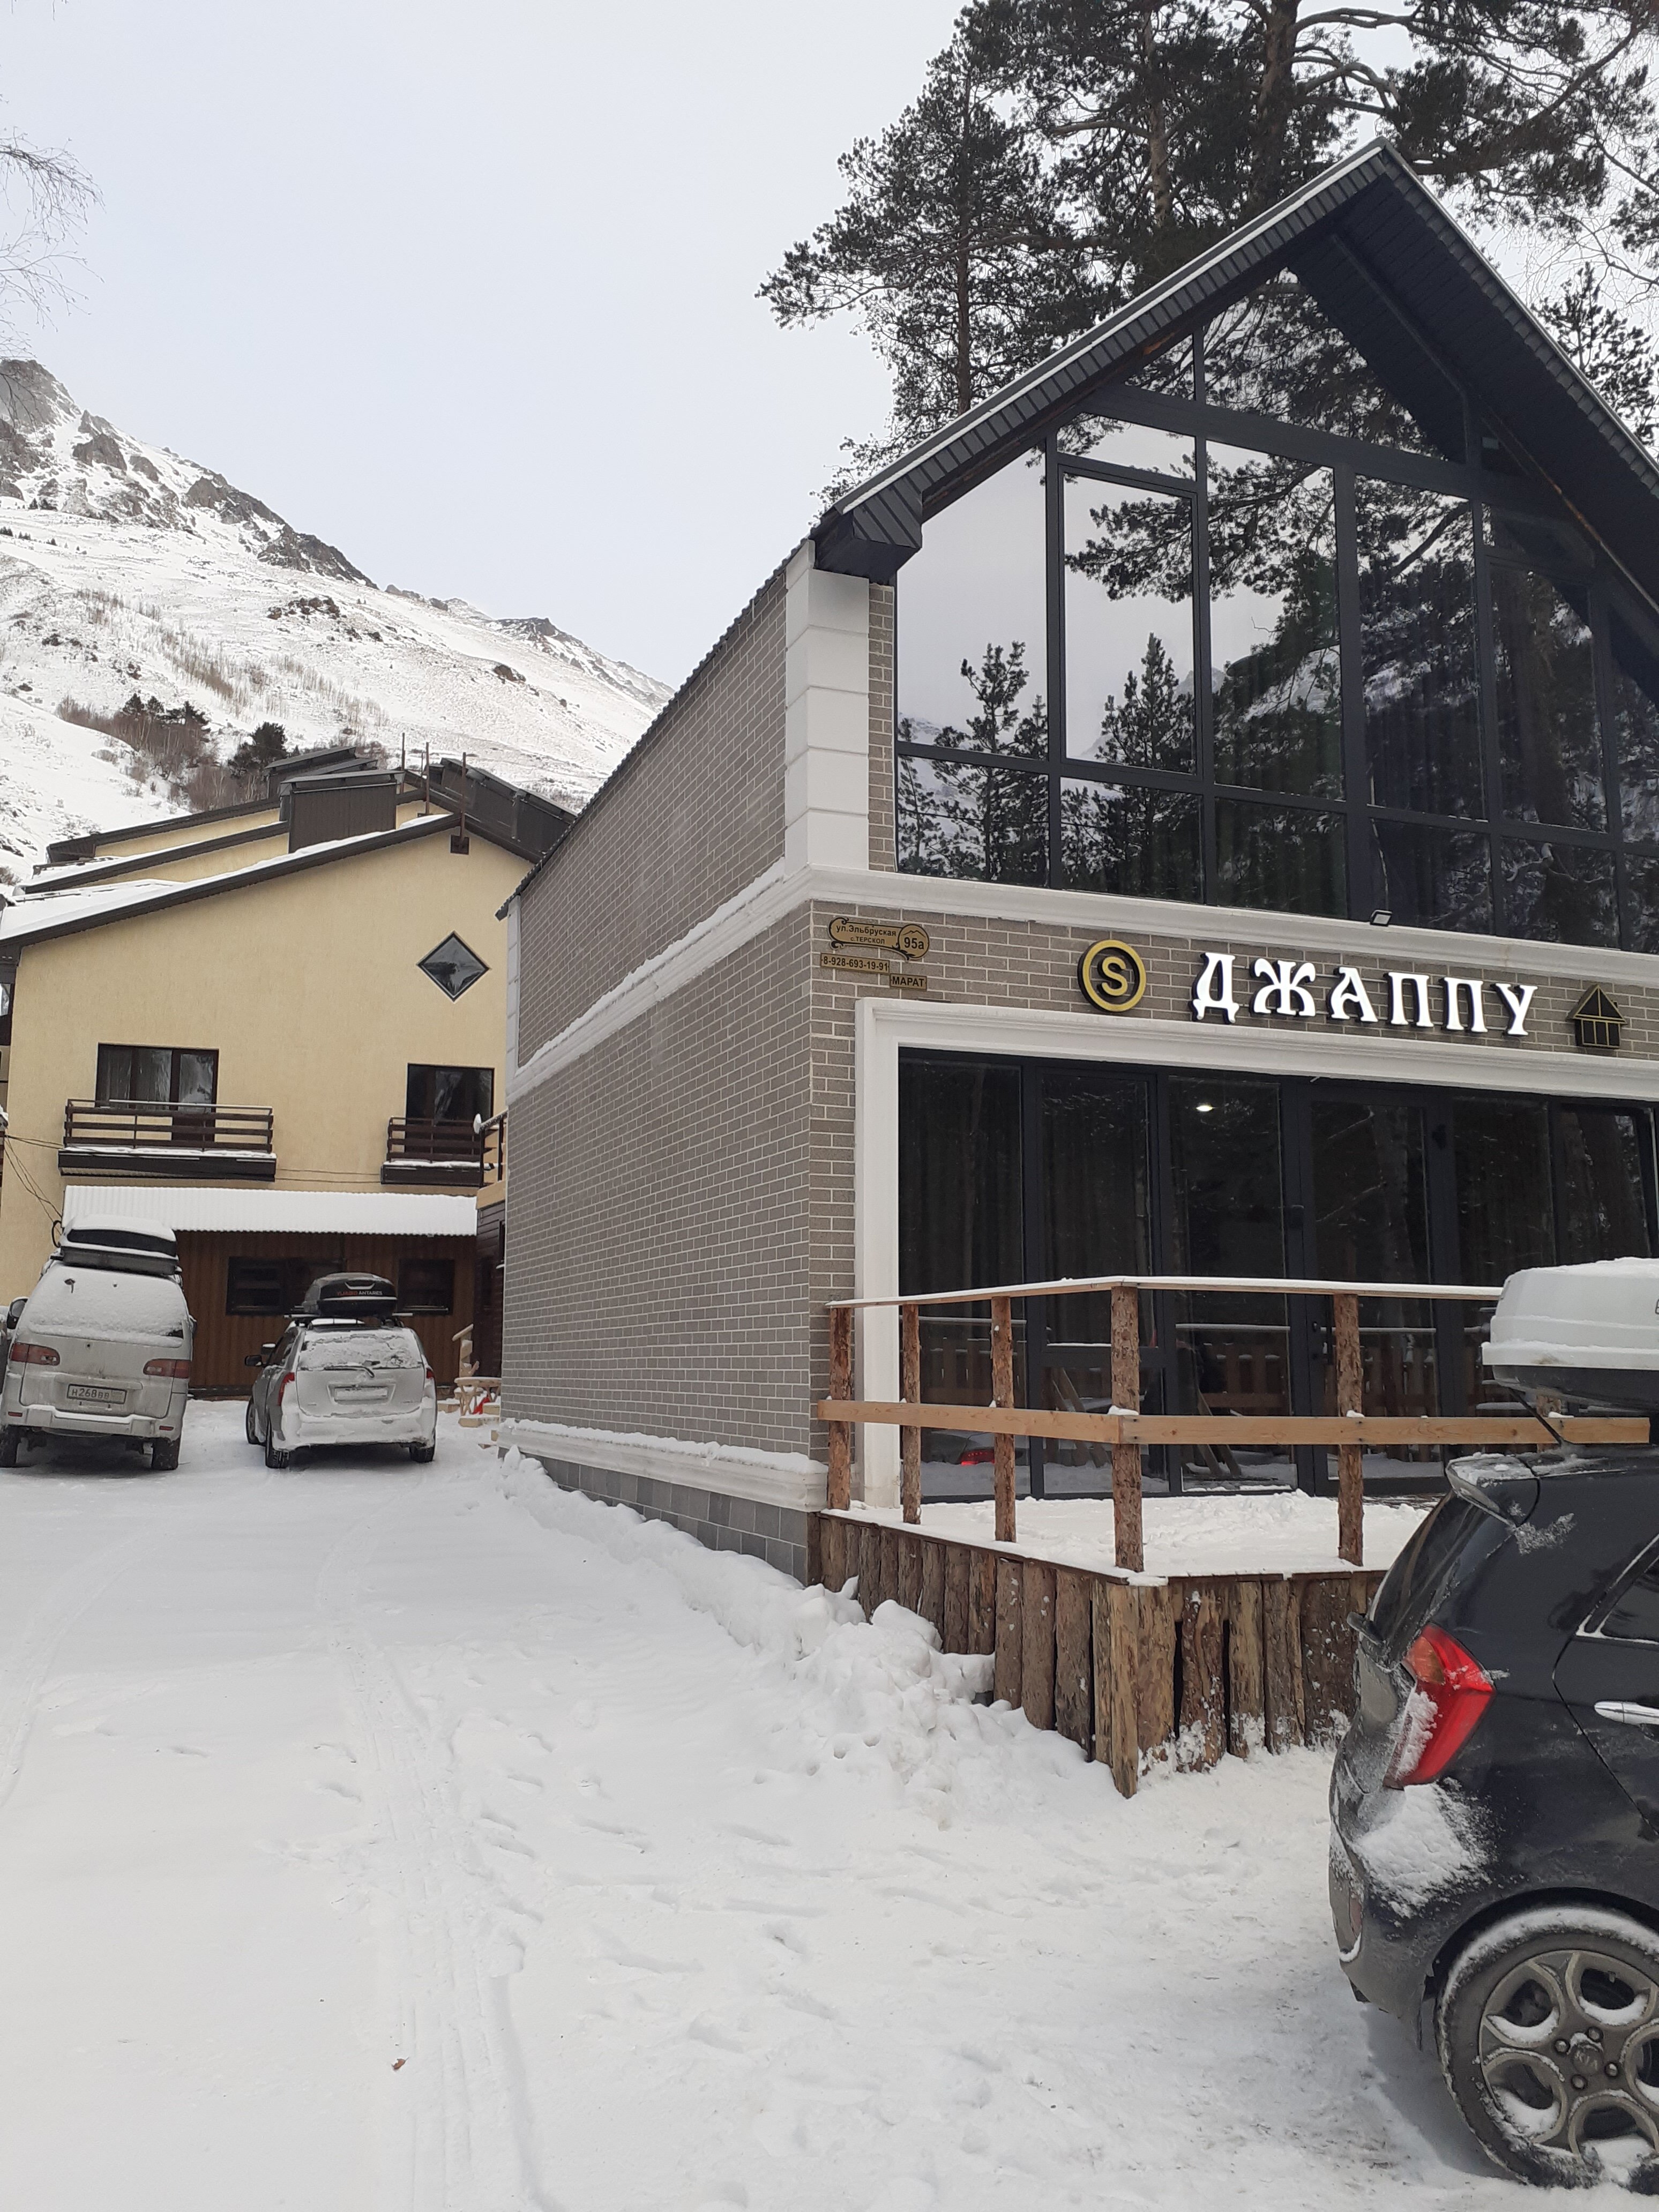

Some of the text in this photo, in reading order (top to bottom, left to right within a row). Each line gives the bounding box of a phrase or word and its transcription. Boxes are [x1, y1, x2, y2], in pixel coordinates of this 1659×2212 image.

[904, 937, 924, 950] 95а
[823, 956, 888, 971] 8-928-693-19-91
[892, 976, 925, 988] МАРАТ
[1100, 955, 1129, 997] S
[1190, 952, 1538, 1036] ДЖАППУ
